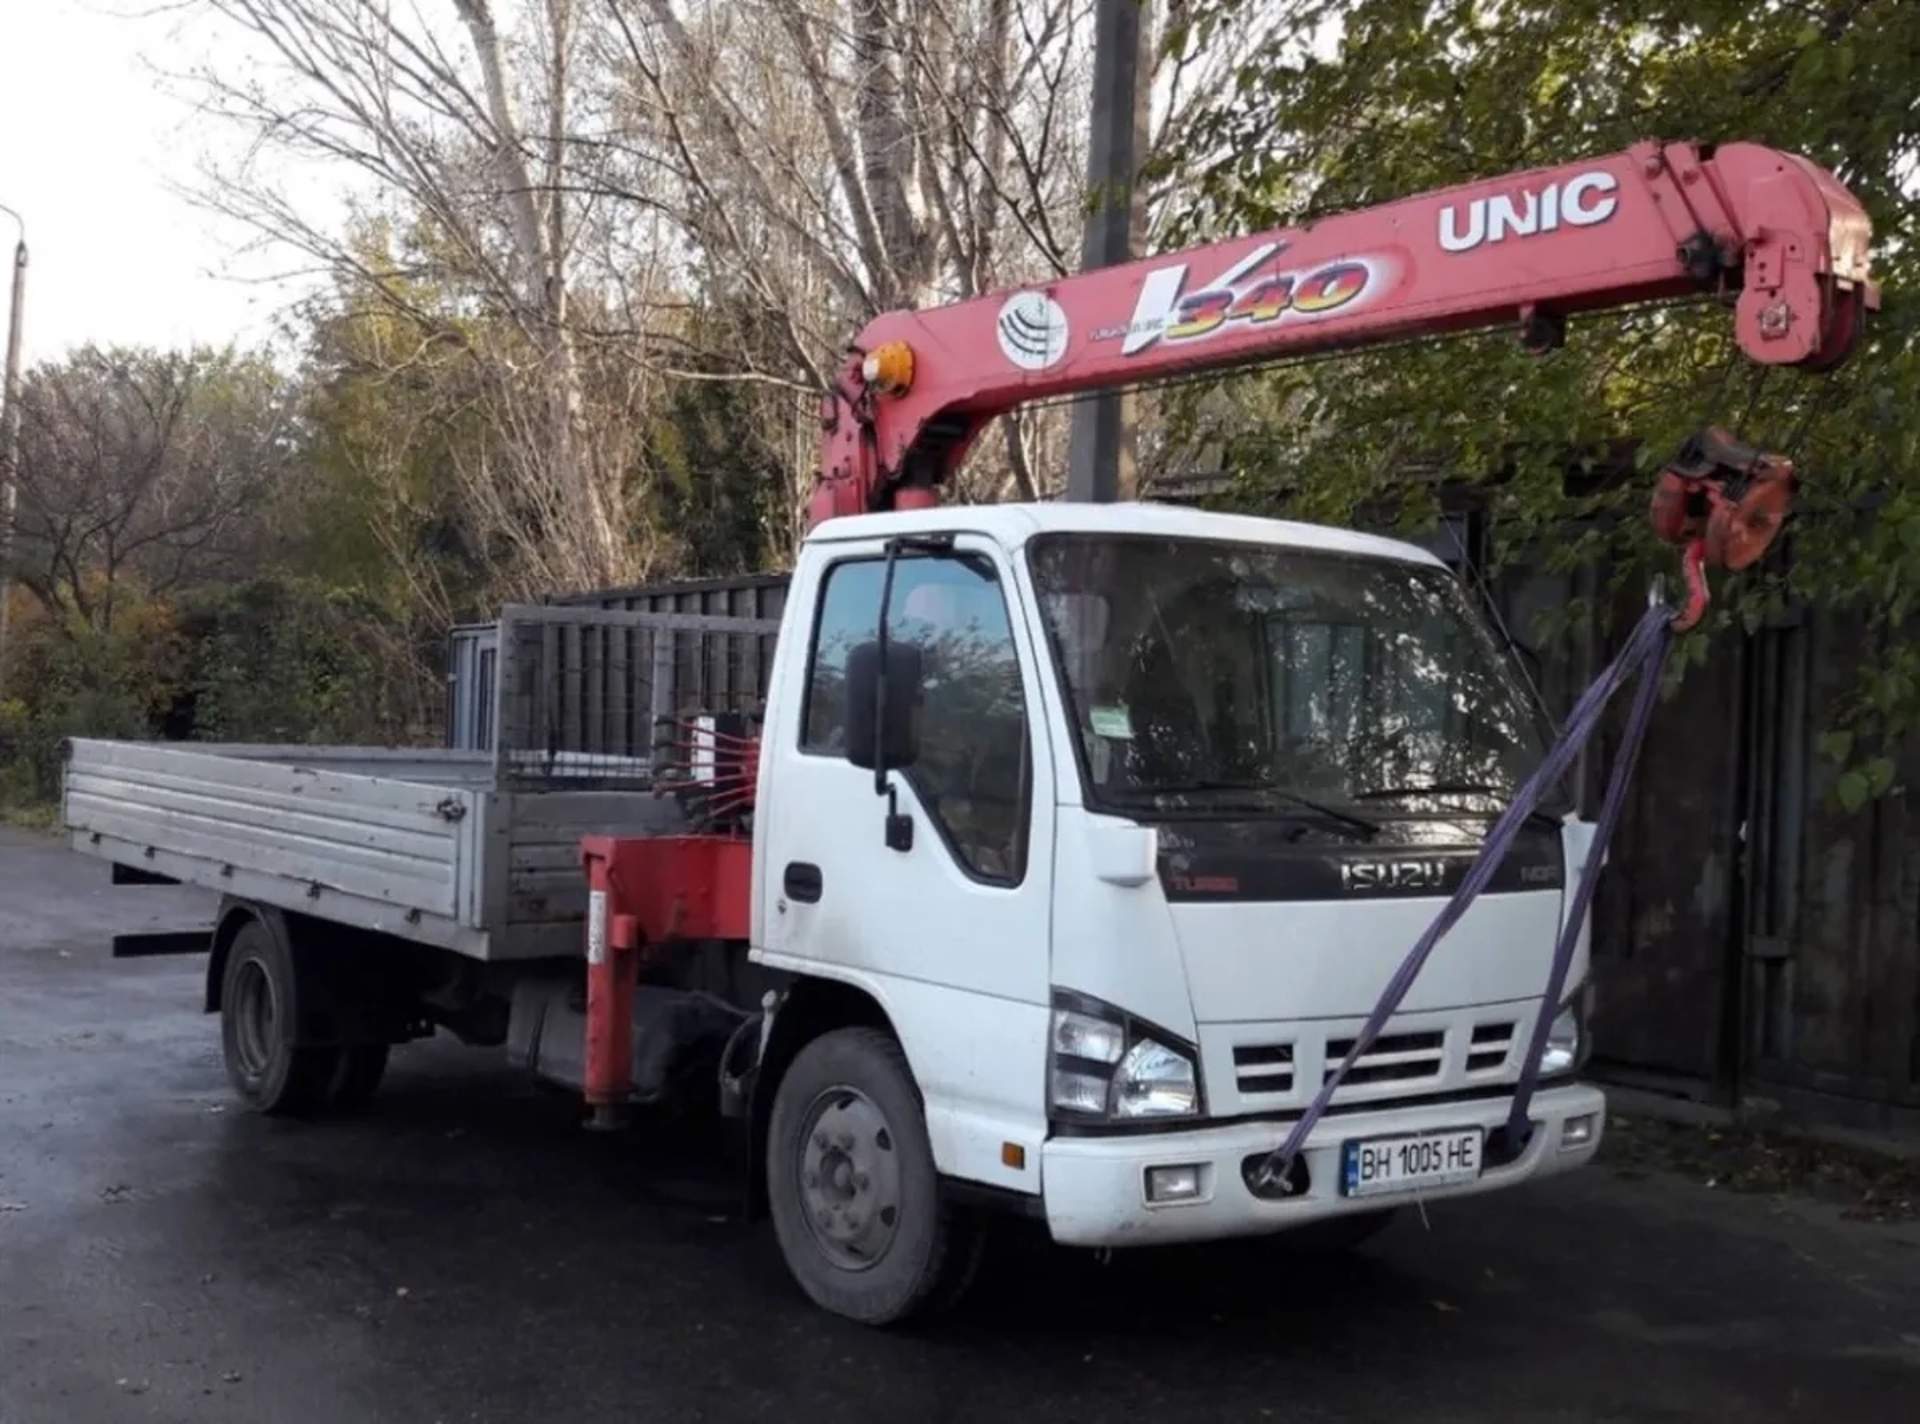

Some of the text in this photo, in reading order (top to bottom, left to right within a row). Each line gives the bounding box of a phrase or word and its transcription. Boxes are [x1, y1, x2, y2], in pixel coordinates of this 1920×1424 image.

[1439, 171, 1618, 252] UNIC
[1341, 862, 1445, 889] ISUZU
[1361, 1148, 1392, 1180] BH
[1398, 1140, 1442, 1175] 1005
[1448, 1136, 1475, 1168] HE
